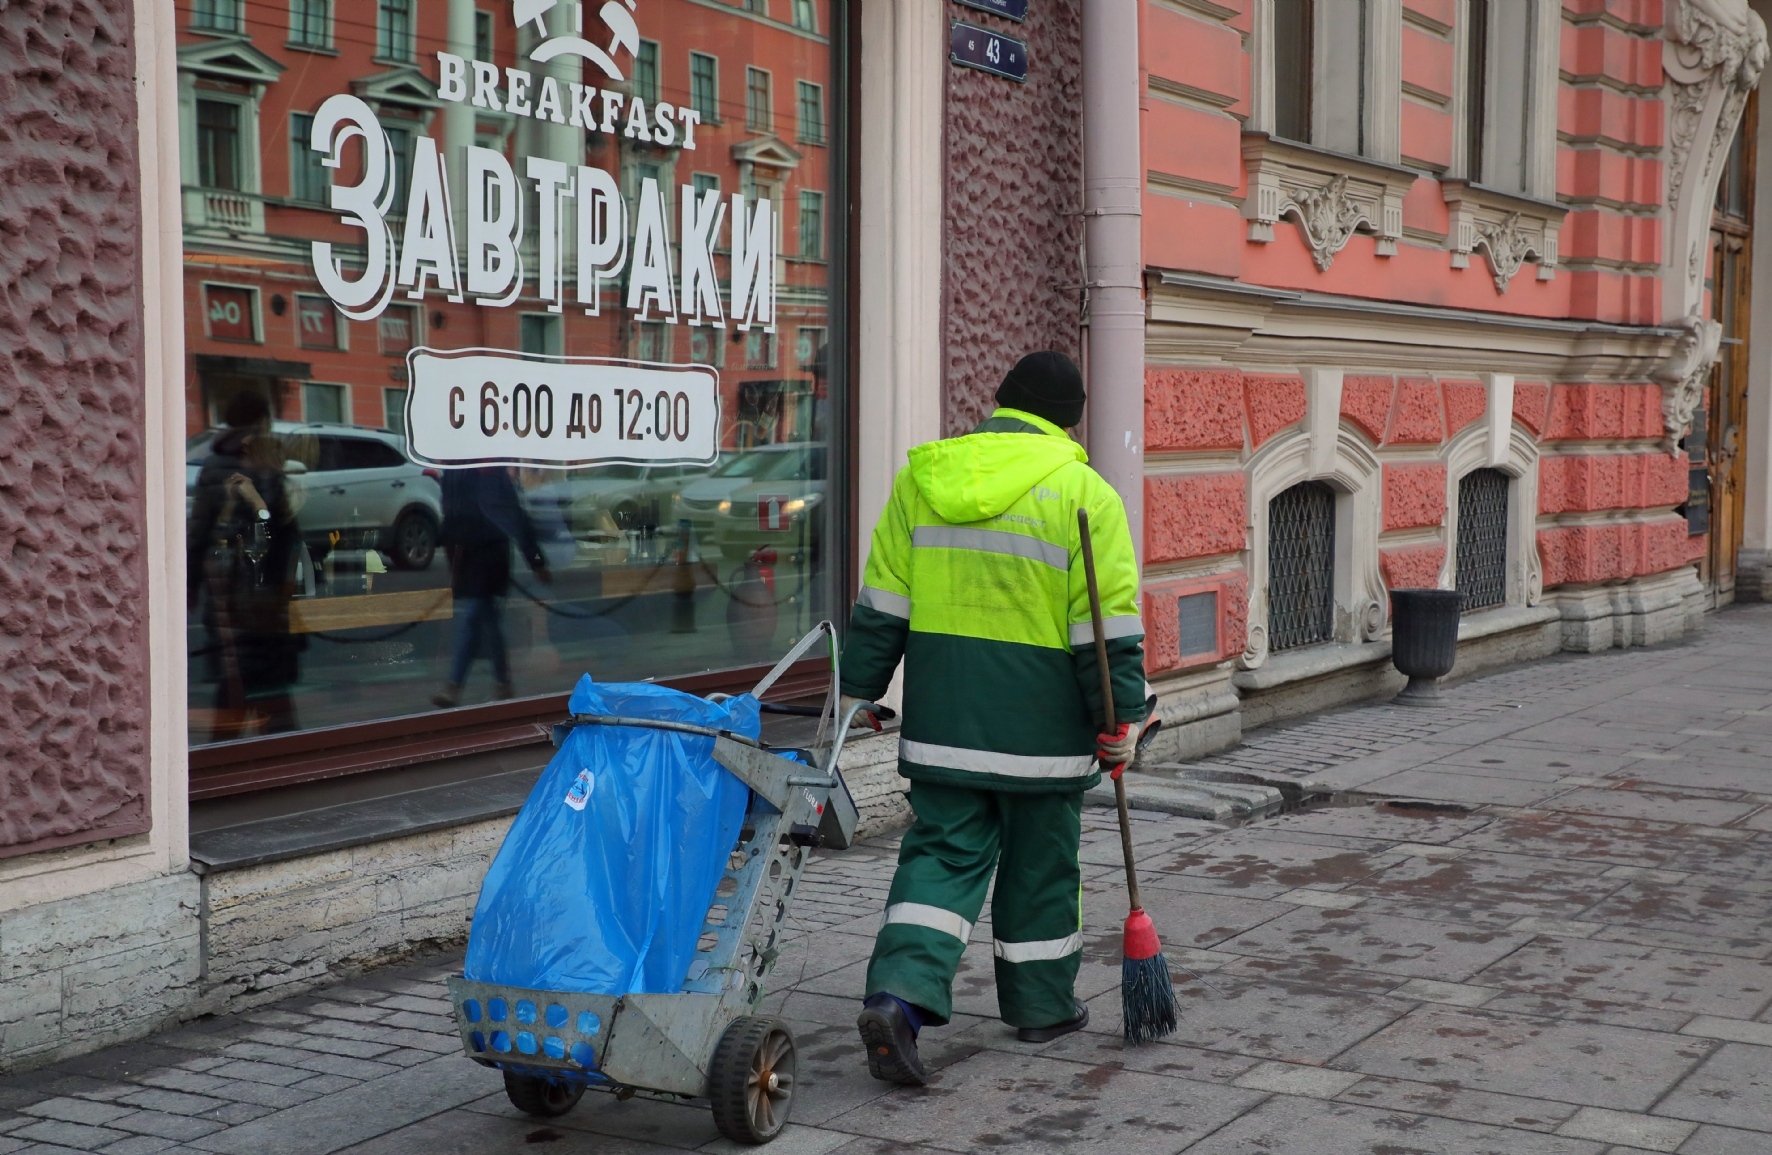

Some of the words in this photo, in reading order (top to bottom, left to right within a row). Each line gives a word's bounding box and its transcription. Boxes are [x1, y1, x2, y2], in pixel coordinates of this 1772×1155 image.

[968, 40, 975, 51] 45
[986, 38, 1000, 64] 43
[437, 52, 700, 151] BREAKFAST
[311, 94, 777, 334] ЗАВТРАКИ
[478, 380, 554, 439] 6:00
[613, 388, 691, 442] 12:00
[993, 513, 1046, 528] роспект
